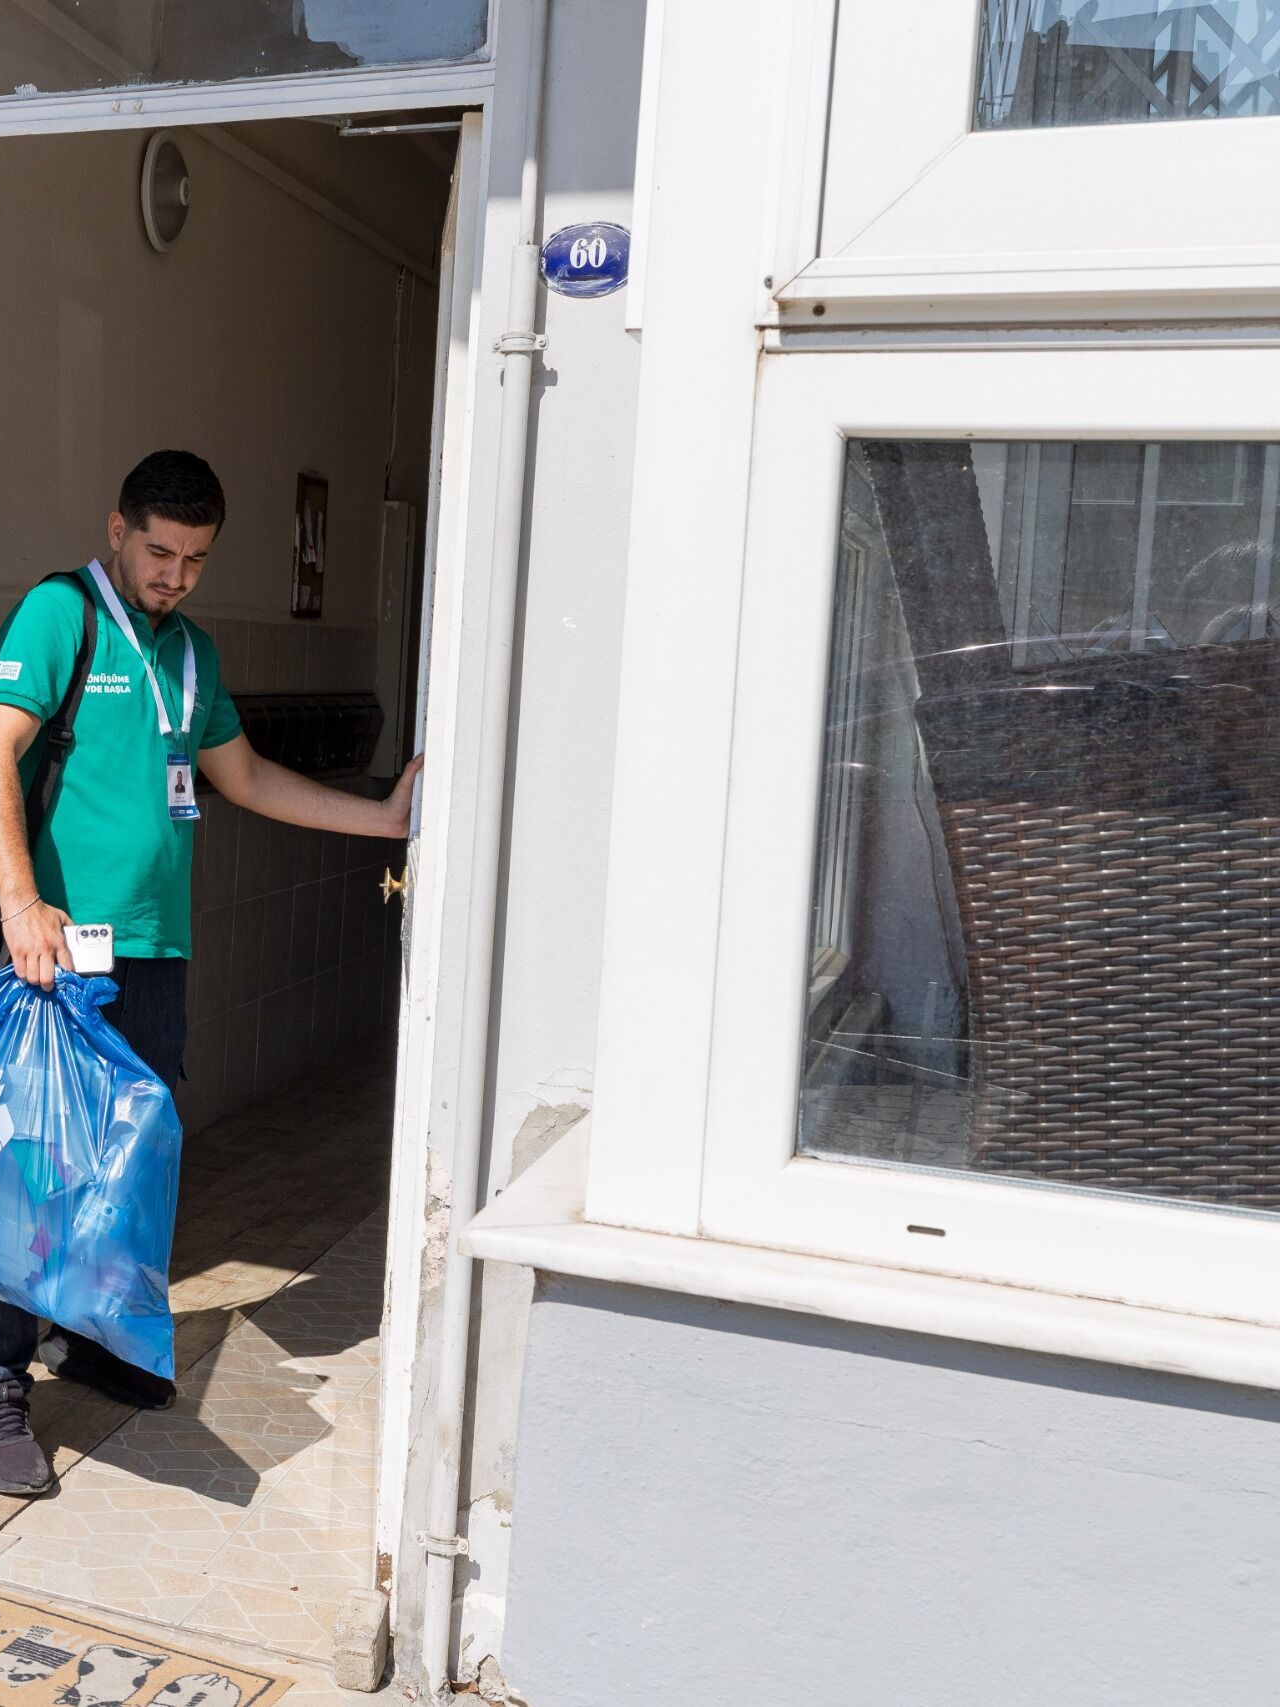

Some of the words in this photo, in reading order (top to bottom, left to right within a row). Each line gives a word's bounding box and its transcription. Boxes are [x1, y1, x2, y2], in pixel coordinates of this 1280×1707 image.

[569, 237, 607, 269] 60
[87, 672, 130, 685] ÖNÜŞÜME
[84, 685, 103, 694] VDE
[104, 685, 132, 695] BAŞLA
